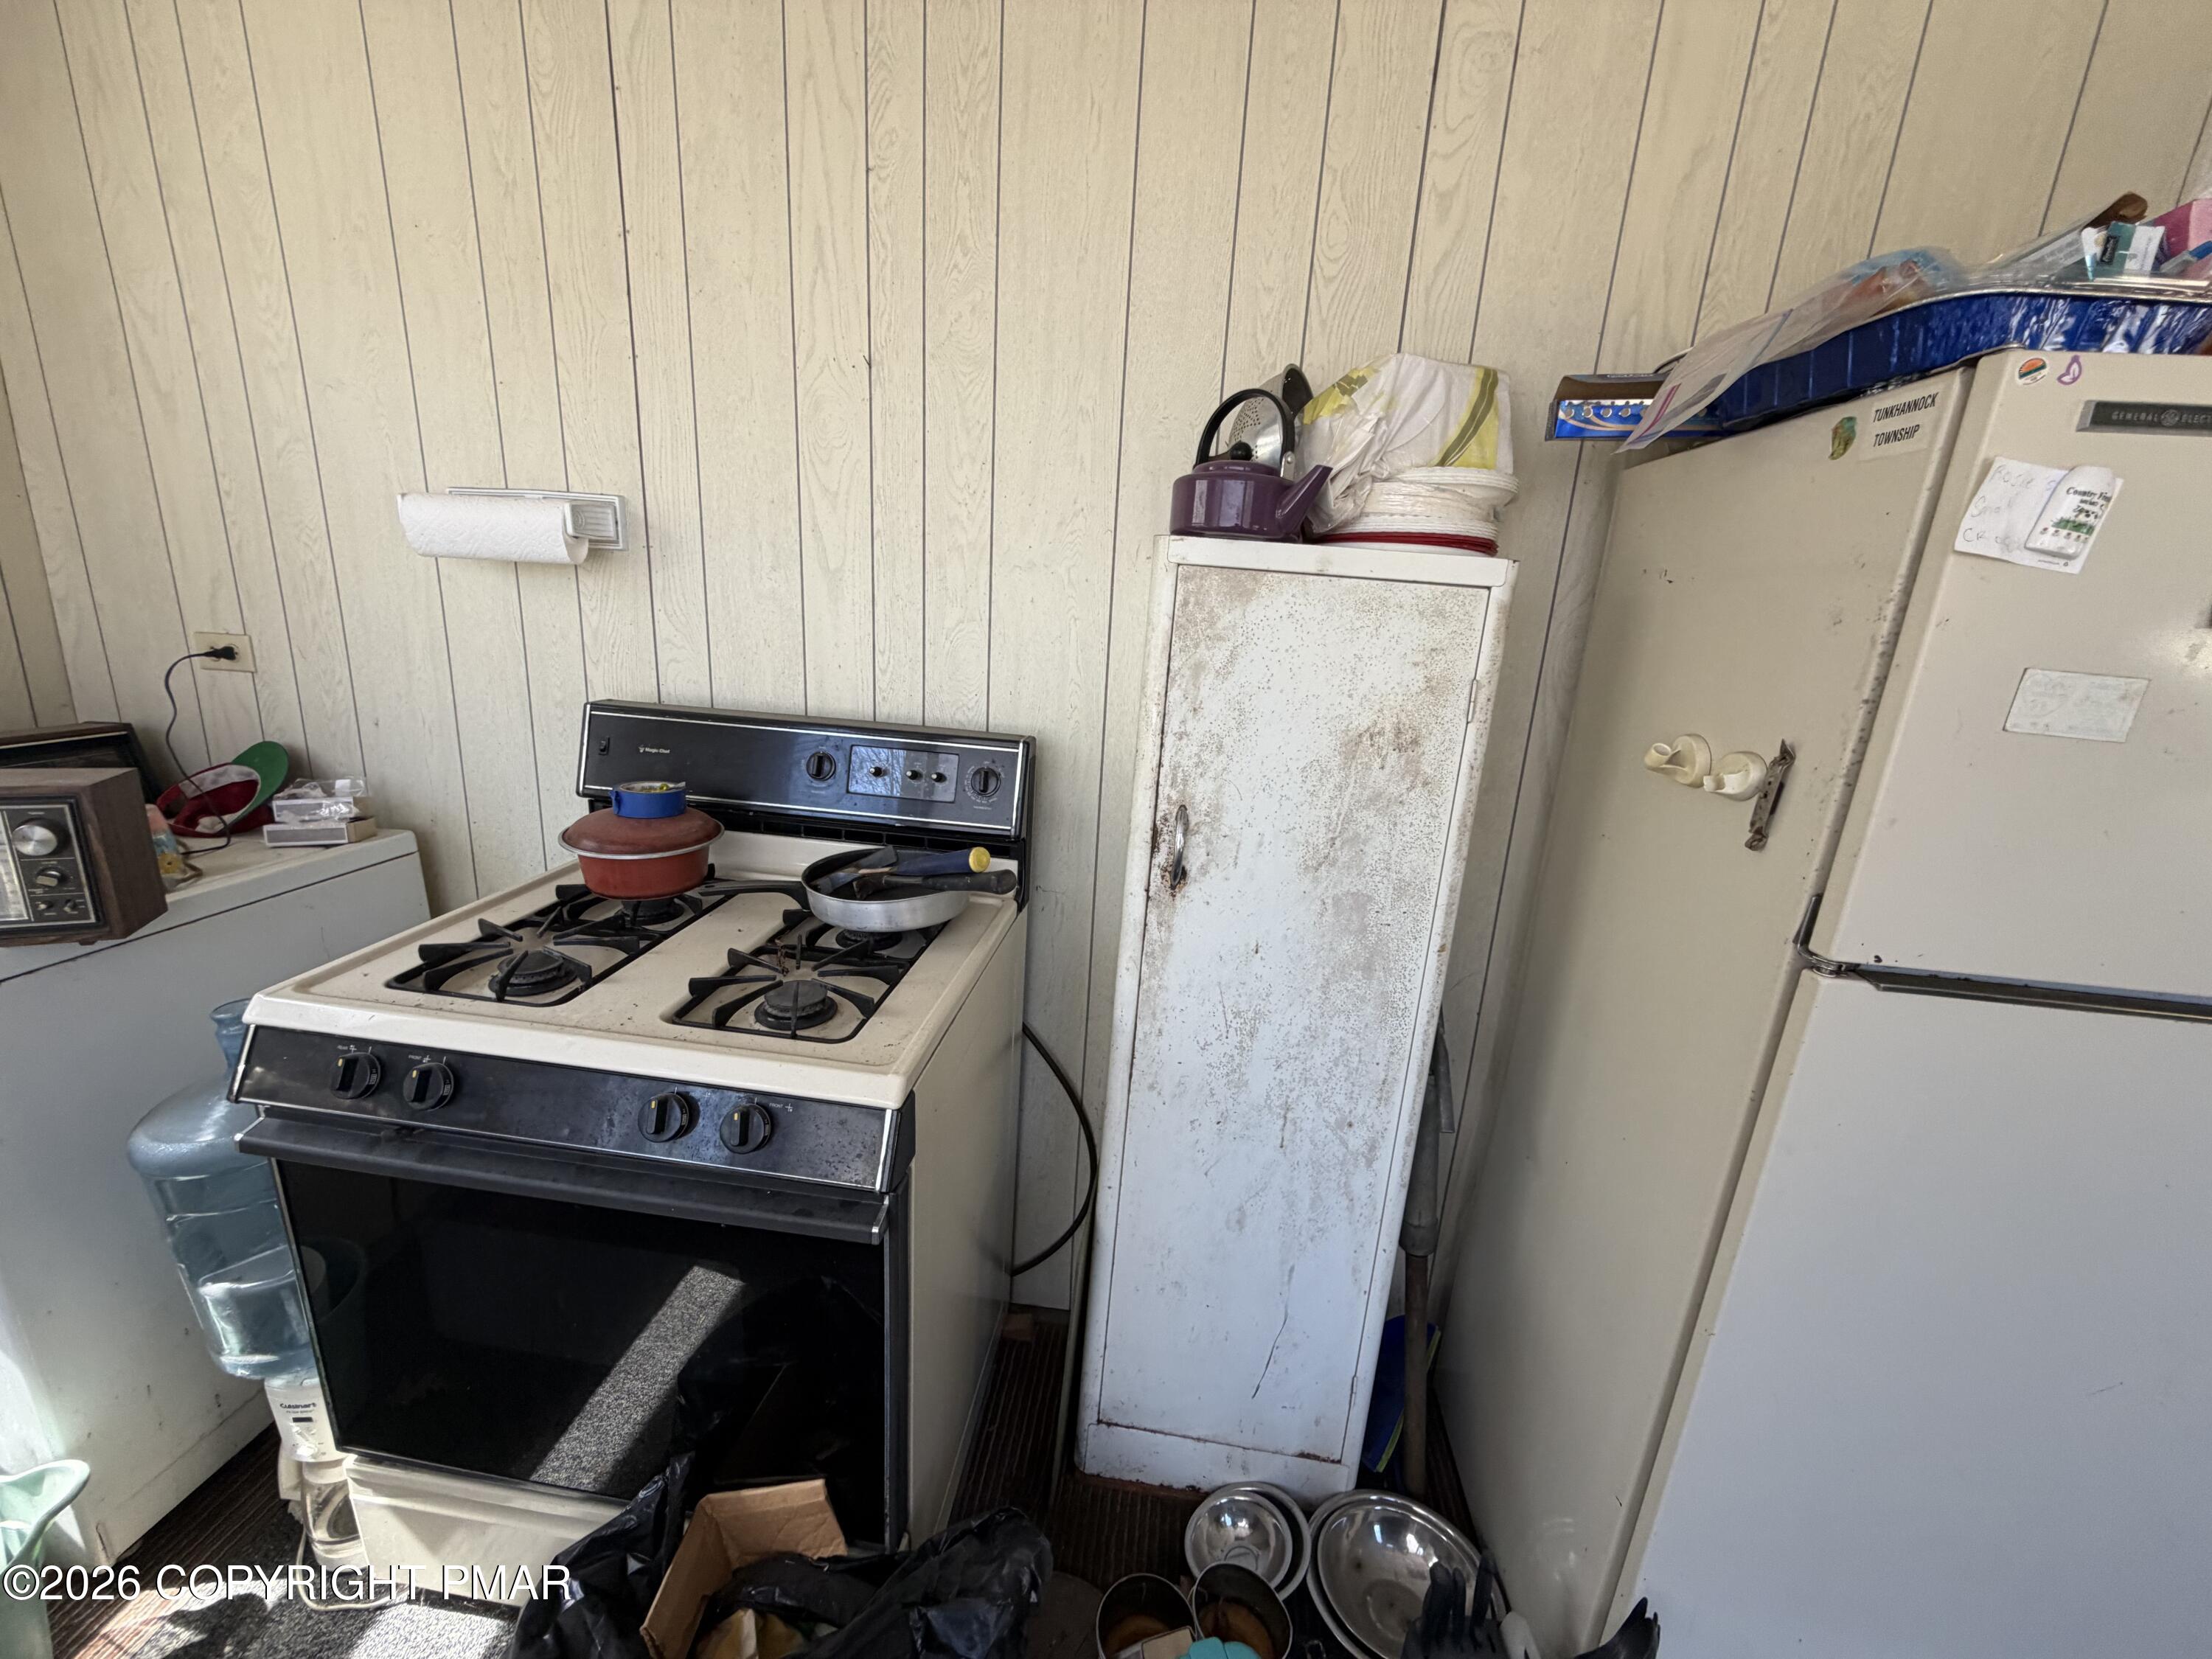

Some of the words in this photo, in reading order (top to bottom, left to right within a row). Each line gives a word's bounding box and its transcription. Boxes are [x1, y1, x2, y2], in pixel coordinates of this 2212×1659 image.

[1873, 392, 1939, 423] TUNKHANNOCK
[2111, 411, 2157, 422] GENERAL
[1873, 425, 1920, 447] TOWNSHIP
